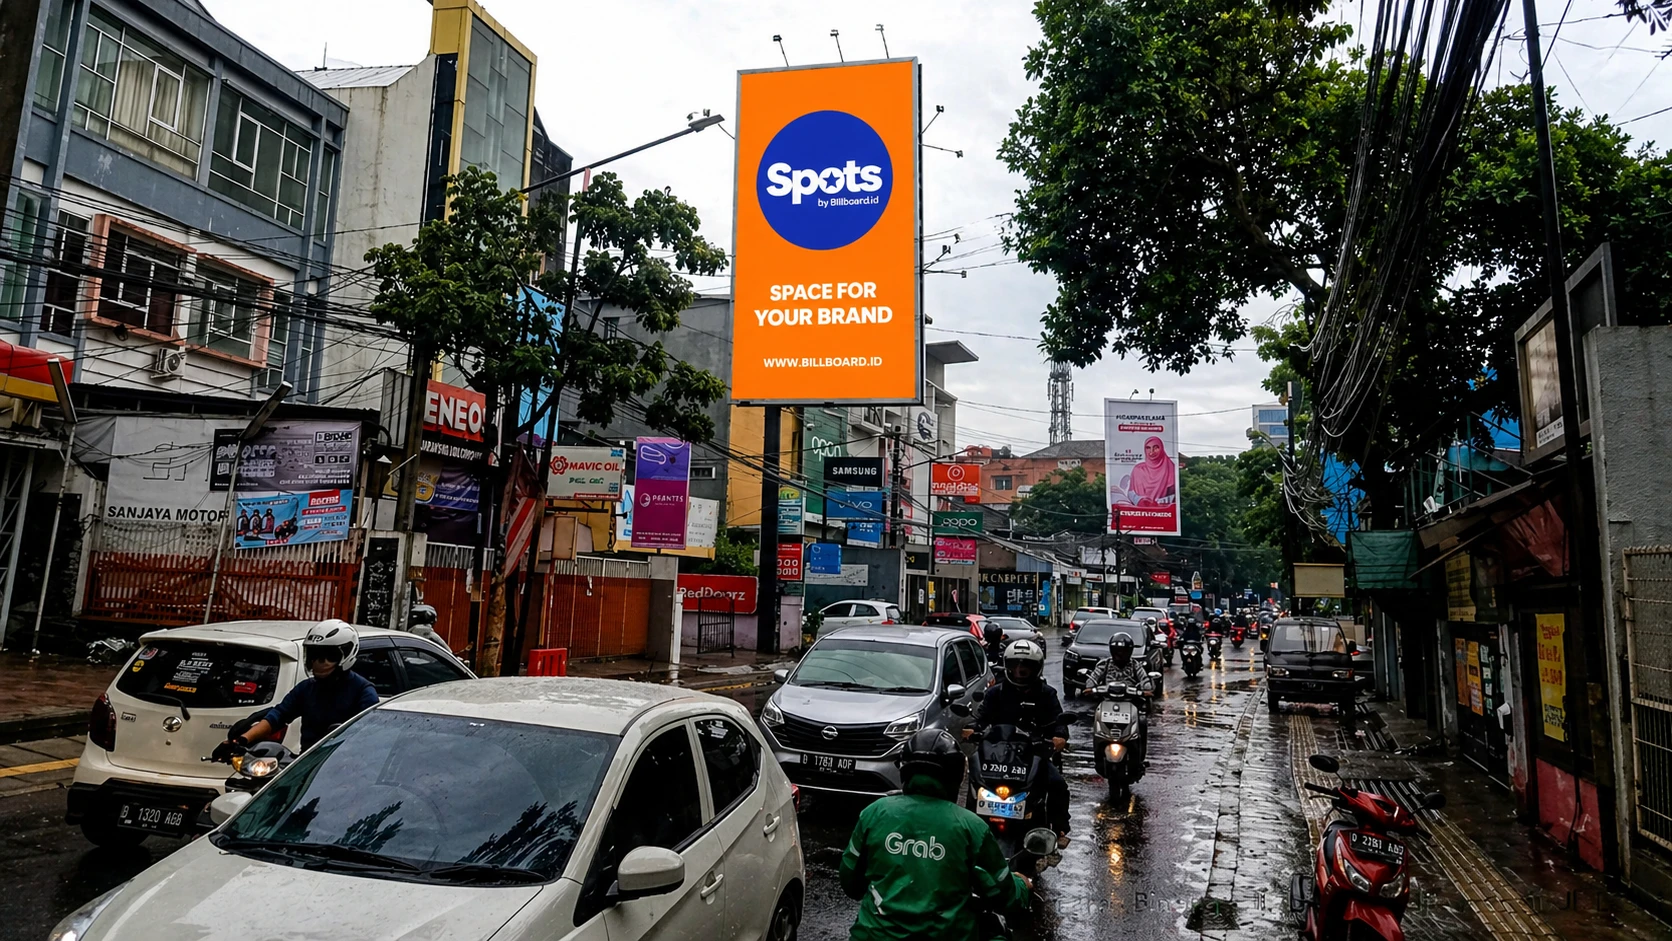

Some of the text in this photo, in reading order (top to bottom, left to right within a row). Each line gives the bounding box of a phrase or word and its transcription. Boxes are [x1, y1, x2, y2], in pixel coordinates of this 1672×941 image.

[766, 160, 883, 205] Spots
[817, 198, 829, 208] by
[769, 281, 877, 301] SPACE FOR
[754, 306, 893, 326] YOUR BRAND
[763, 356, 883, 368] WWW.BILLBOARD.ID
[424, 389, 486, 434] ENEO
[569, 461, 620, 472] MAVIC OIL
[832, 466, 877, 476] SAMSUNG
[107, 505, 172, 521] SANJAYA
[942, 518, 978, 528] oppo
[137, 807, 161, 823] 1320
[884, 831, 946, 861] Grab
